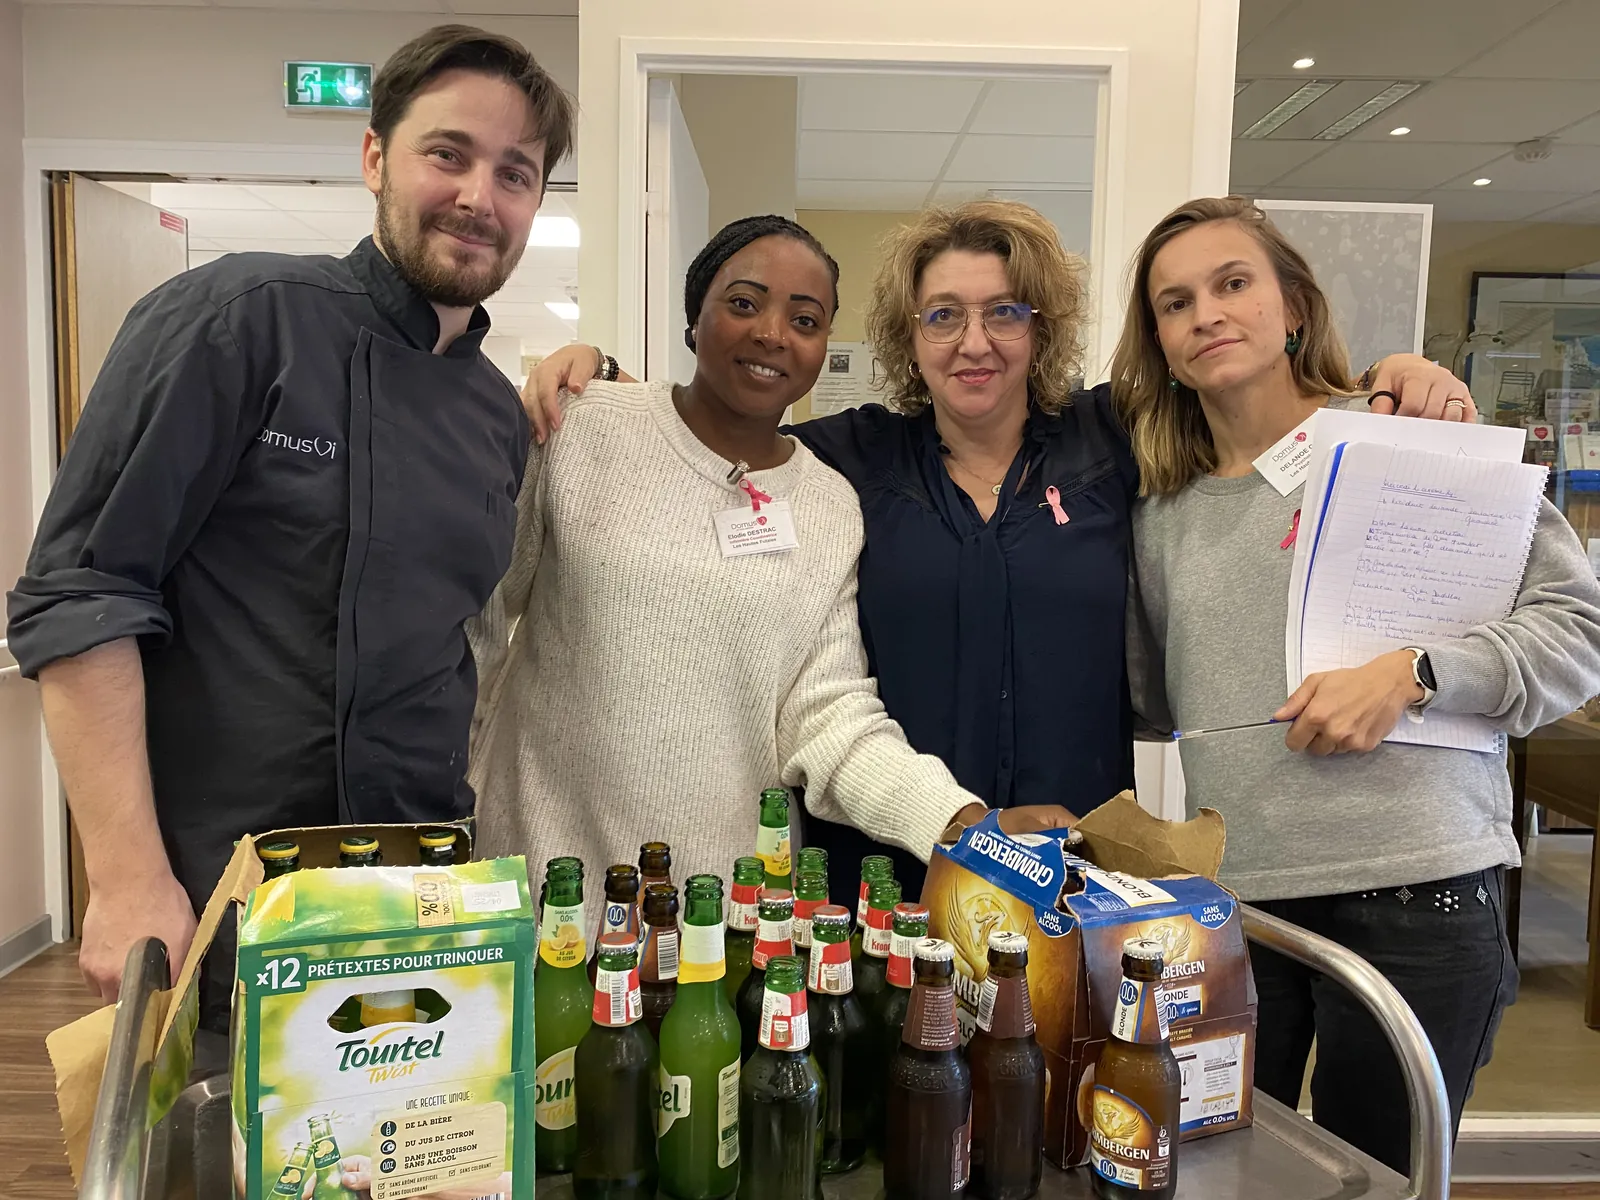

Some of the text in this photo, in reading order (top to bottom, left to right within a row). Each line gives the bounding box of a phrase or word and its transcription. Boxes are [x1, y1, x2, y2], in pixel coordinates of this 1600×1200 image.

[747, 527, 777, 536] DESTRAC
[967, 830, 1054, 888] GRIMBERGEN
[1043, 911, 1060, 924] SANS
[1200, 912, 1226, 923] ALCOOL
[1203, 905, 1220, 915] SANS
[1038, 916, 1063, 934] ALCOOL
[308, 947, 504, 978] PRÉTEXTES POUR TRINQUER
[256, 958, 301, 990] x12
[1163, 989, 1189, 1002] ONDE
[1118, 1006, 1128, 1036] BLONDE
[335, 1030, 445, 1072] Tourtel
[365, 1061, 420, 1084] Twist
[406, 1098, 418, 1110] UNE
[420, 1094, 447, 1108] RECETTE
[430, 1115, 452, 1126] BIÈRE
[446, 1129, 475, 1140] CITRON
[404, 1144, 478, 1162] DANS UNE BOISSON
[404, 1154, 456, 1169] SANS ALCOOL
